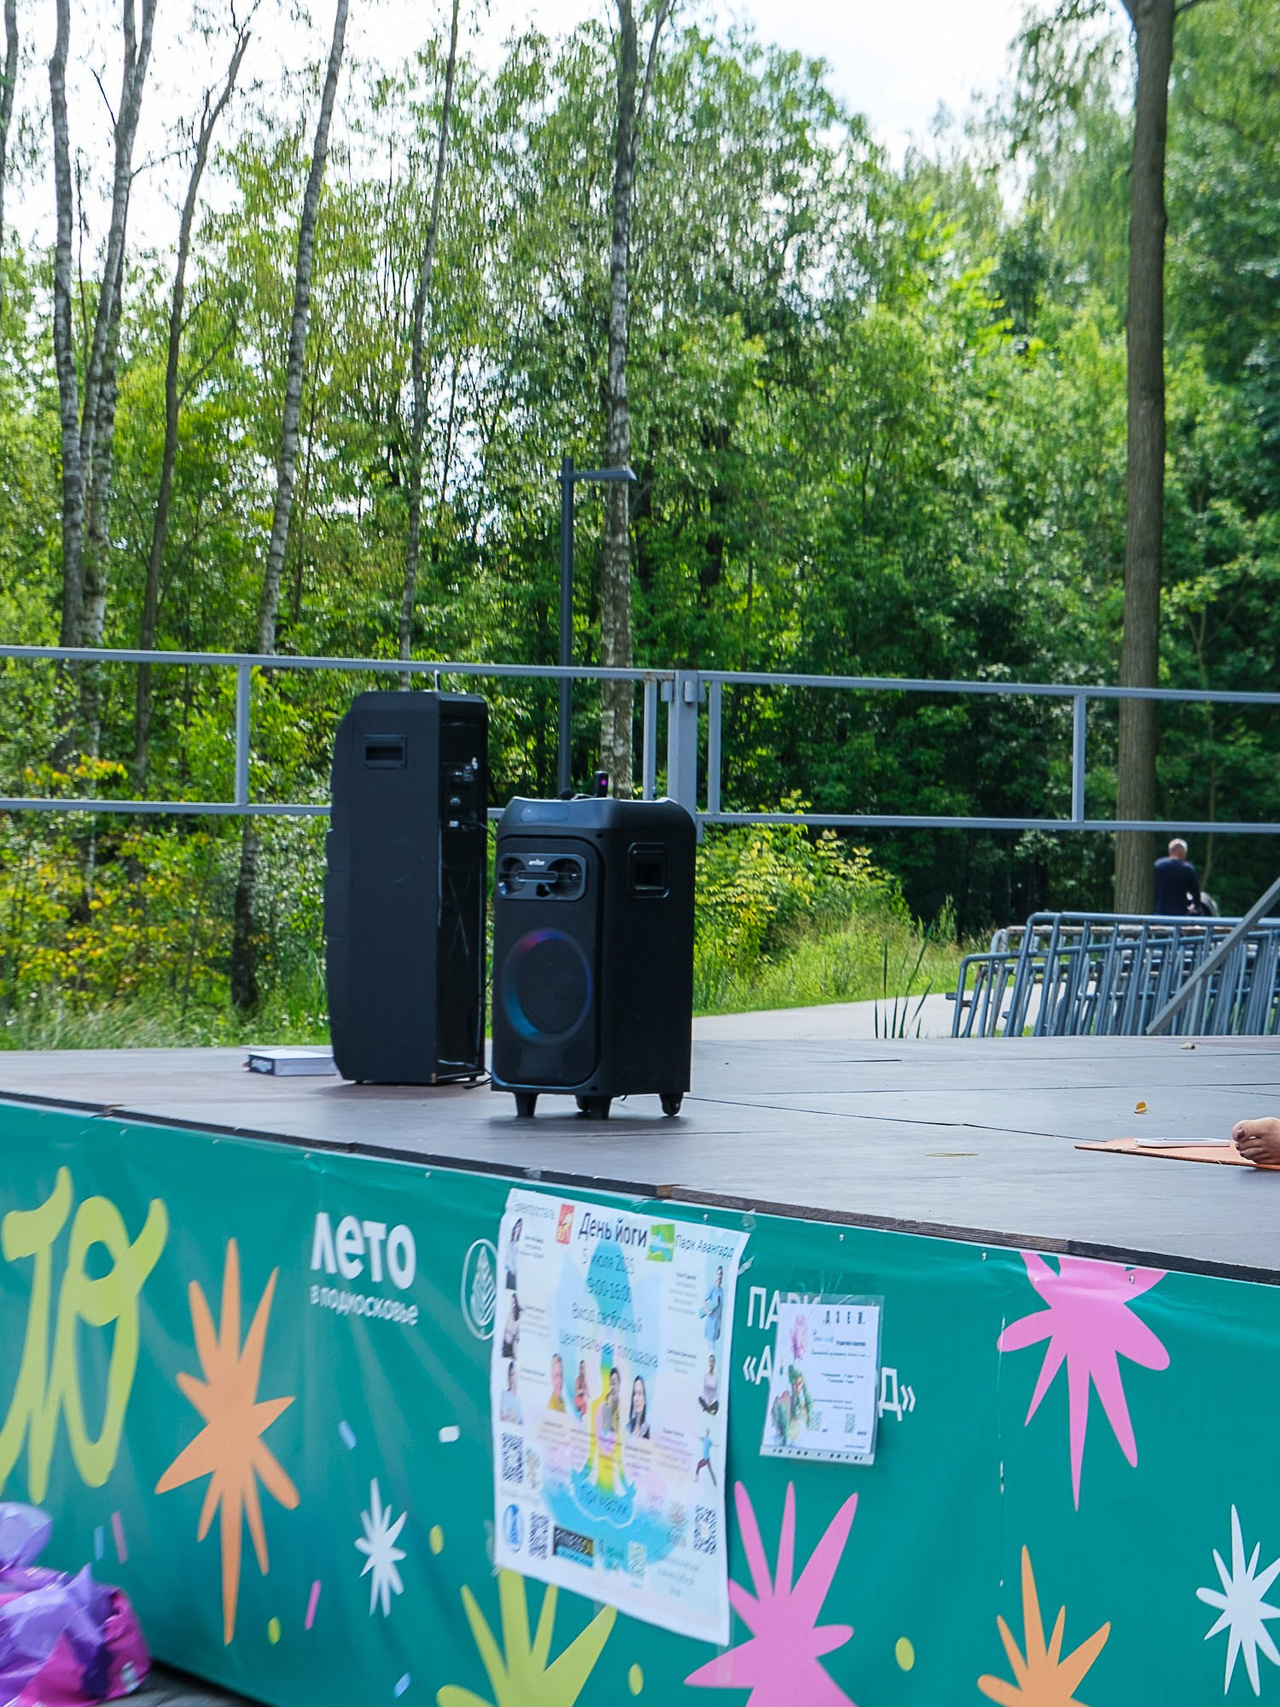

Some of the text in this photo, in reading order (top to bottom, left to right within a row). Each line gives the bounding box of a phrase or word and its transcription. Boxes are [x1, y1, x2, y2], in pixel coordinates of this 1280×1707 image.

[579, 1212, 648, 1248] День йоги
[675, 1234, 734, 1260] Парк Авангард
[310, 1285, 319, 1304] в
